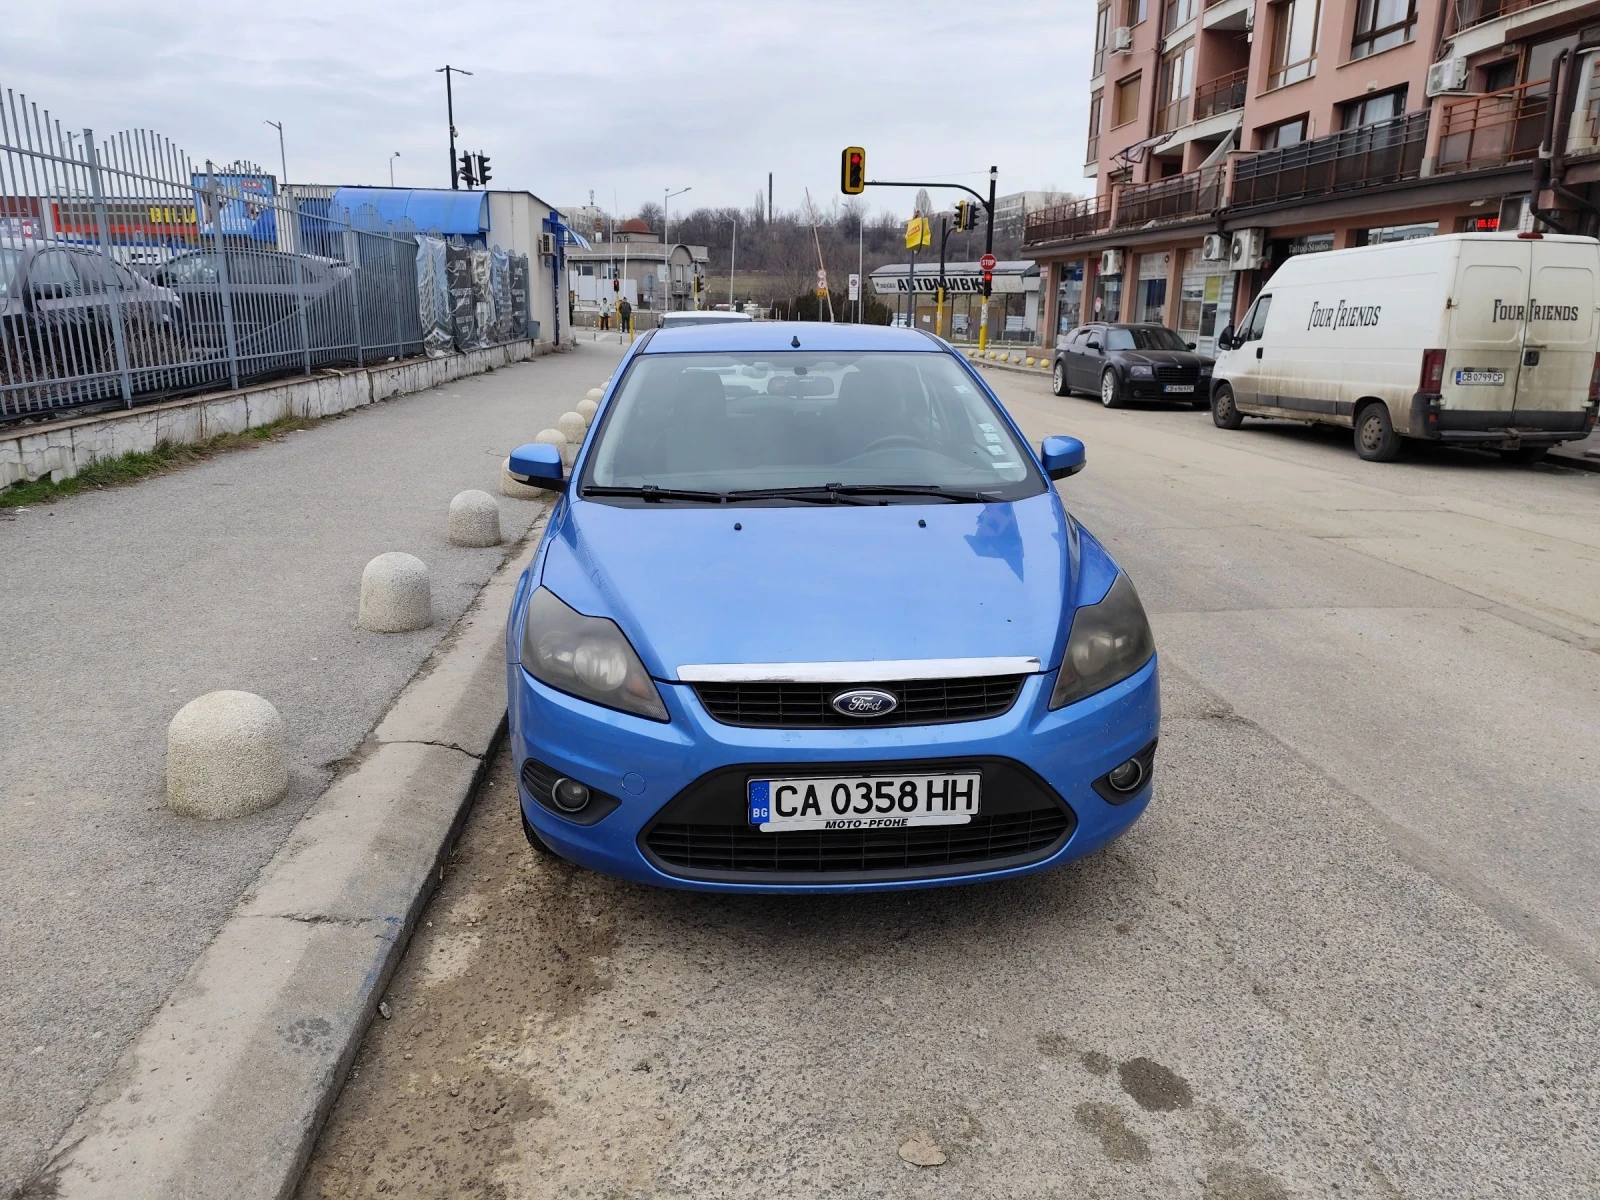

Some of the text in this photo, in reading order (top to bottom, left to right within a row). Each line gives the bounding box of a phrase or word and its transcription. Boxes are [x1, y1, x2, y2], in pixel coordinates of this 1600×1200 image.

[896, 277, 985, 292] АВТОМИВК
[1473, 373, 1492, 382] 0799
[848, 696, 882, 711] Ford
[775, 779, 974, 817] CA 0358 HH
[752, 807, 768, 818] BG
[824, 818, 909, 829] MOTO-PFOHE
